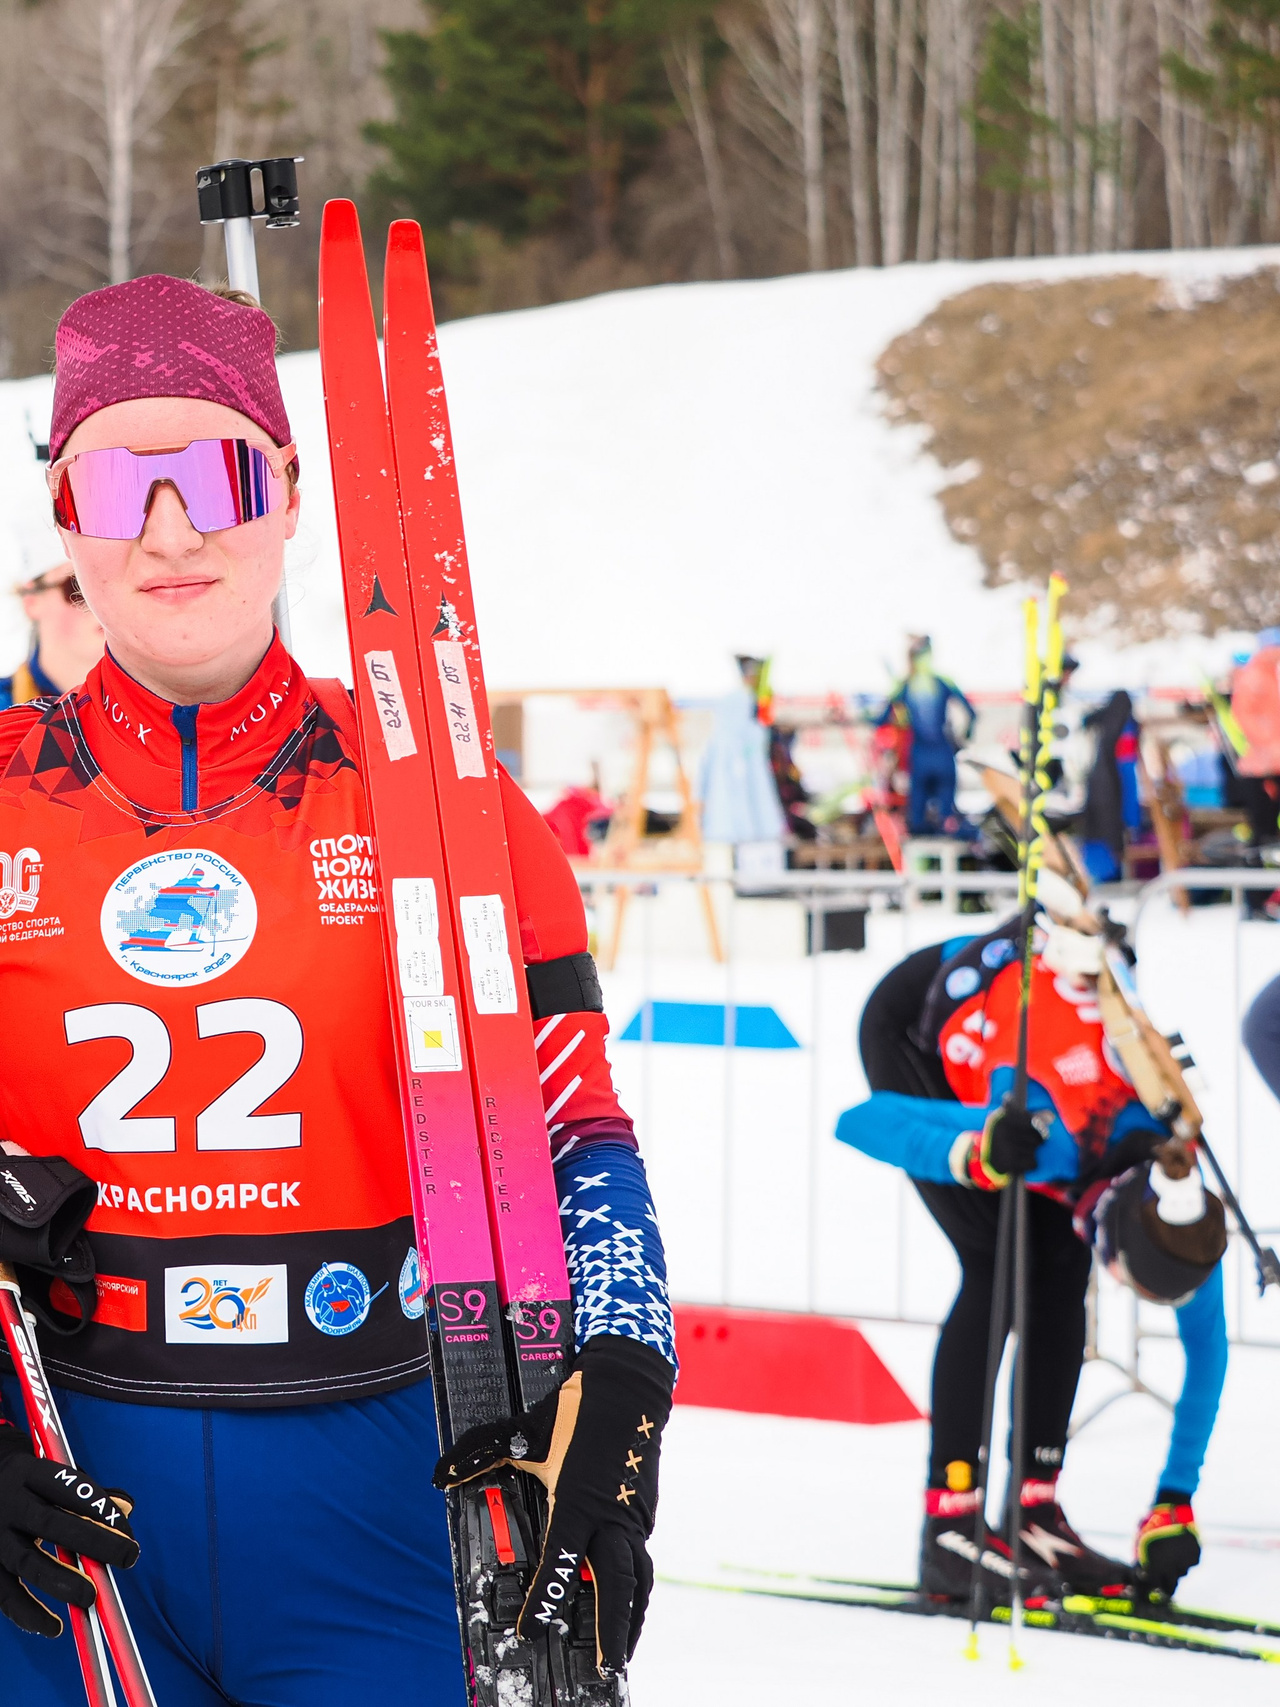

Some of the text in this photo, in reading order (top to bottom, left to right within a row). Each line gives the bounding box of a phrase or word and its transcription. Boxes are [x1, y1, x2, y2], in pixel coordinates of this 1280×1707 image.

[24, 863, 44, 874] ЛЕТ
[115, 853, 242, 891] ПЕРВЕНСТВО РОССИИ
[312, 855, 374, 879] НОРМ
[316, 878, 378, 900] ЖИЗН
[26, 917, 61, 929] СПОРТА
[319, 902, 379, 914] ФЕДЕРАЛЬ
[321, 915, 364, 925] ПРОЕКТ
[8, 927, 65, 942] ФЕДЕРАЦИИ
[130, 960, 199, 981] Красноярск
[203, 952, 232, 974] 2023
[410, 1000, 433, 1008] YOUR
[63, 996, 304, 1154] 22
[411, 1078, 437, 1195] REDSTER
[485, 1097, 512, 1213] REDSTER
[96, 1181, 302, 1213] КРАСНОЯРСК
[94, 1278, 139, 1296] АСНОЯРСКИЙ
[346, 1263, 370, 1296] БИАТЛОНА
[179, 1276, 245, 1331] 20 ЛЕТ
[439, 1289, 487, 1322] S9
[445, 1332, 489, 1343] CARBON
[515, 1308, 561, 1340] S9
[10, 1322, 58, 1436] SWIX
[54, 1468, 120, 1527] MOAX
[534, 1547, 578, 1623] MOAX
